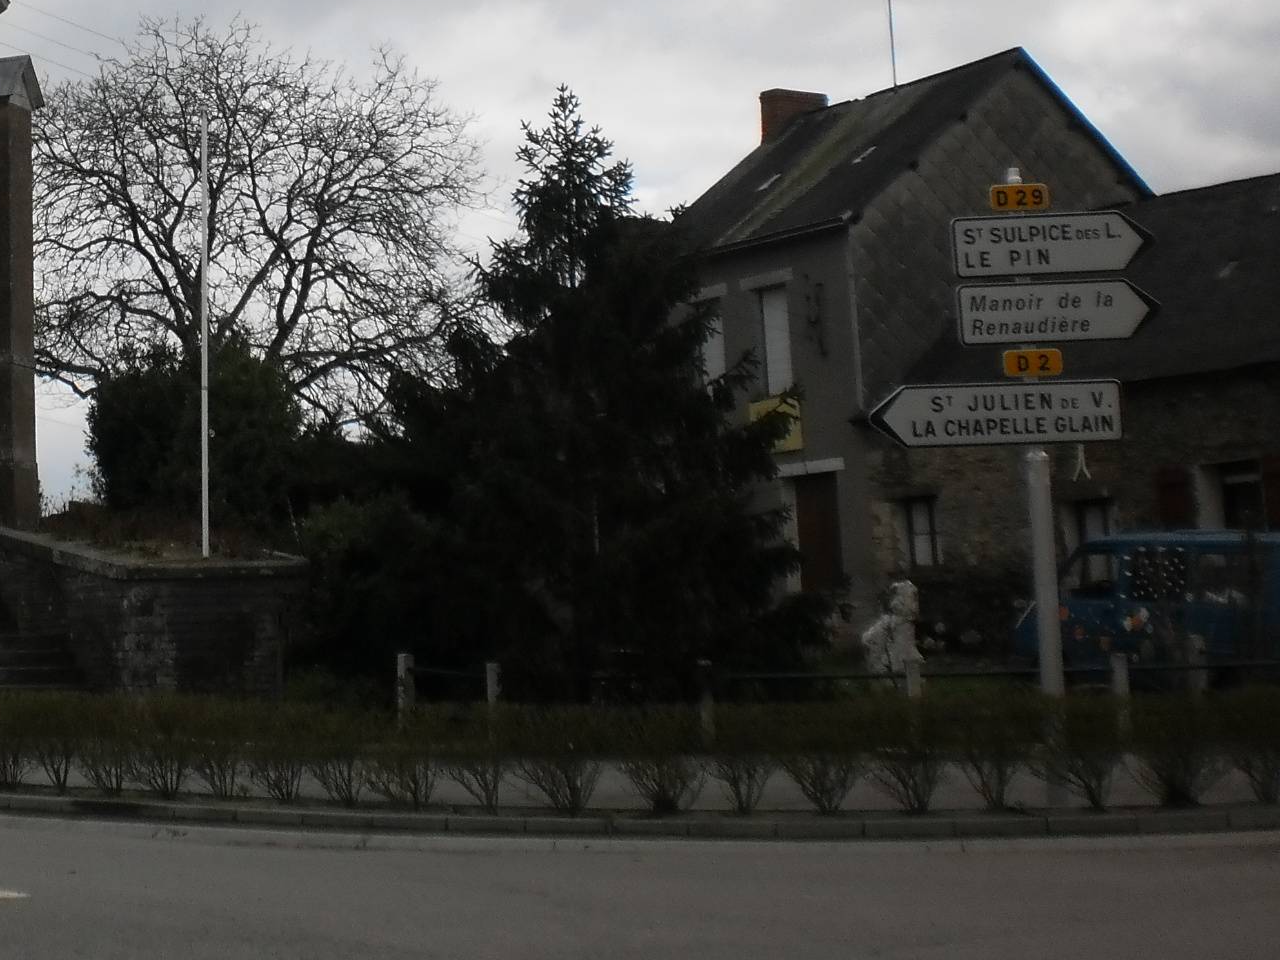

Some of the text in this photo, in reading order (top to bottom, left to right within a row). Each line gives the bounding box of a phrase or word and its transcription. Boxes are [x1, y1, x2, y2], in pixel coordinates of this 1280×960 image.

[996, 189, 1043, 207] D 29
[990, 223, 1072, 243] SULPICE
[1076, 228, 1100, 240] DES
[1105, 222, 1122, 240] L.
[964, 249, 1051, 269] LE PIN
[970, 291, 1113, 312] Manoir de la
[971, 317, 1091, 336] Renaudière
[1017, 354, 1050, 372] D 2
[967, 393, 1052, 412] JULIEN
[1061, 397, 1079, 409] DE
[1090, 391, 1112, 408] V.
[911, 414, 1114, 438] LA CHAPELLE GLAIN
